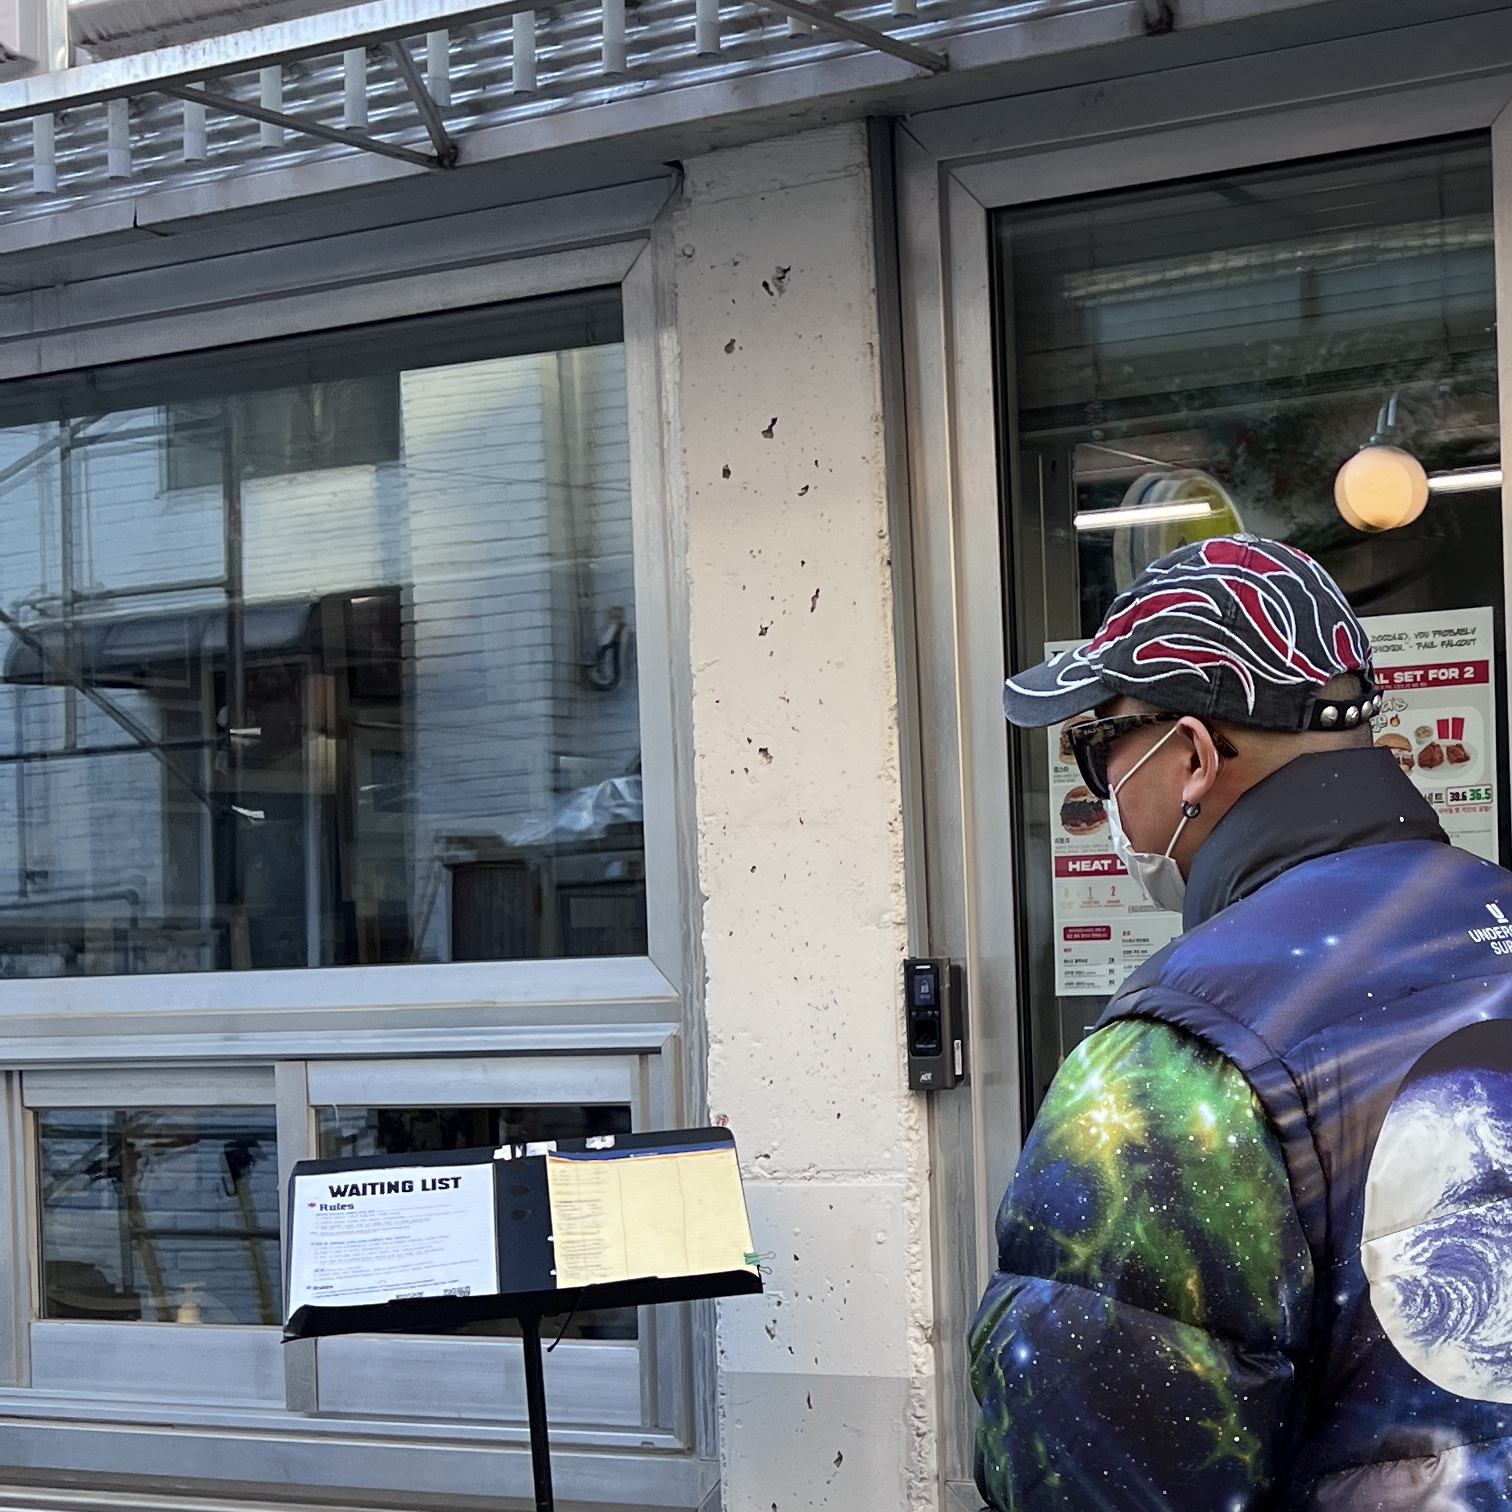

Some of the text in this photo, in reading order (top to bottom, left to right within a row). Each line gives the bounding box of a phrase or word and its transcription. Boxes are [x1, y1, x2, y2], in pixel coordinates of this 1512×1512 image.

[1393, 670, 1424, 683] SET
[1428, 667, 1460, 681] FOR
[1464, 666, 1475, 678] 2
[1068, 860, 1112, 872] HEAT
[1111, 886, 1116, 896] 2
[328, 1176, 462, 1198] WAITING LIST
[319, 1202, 354, 1211] Rules
